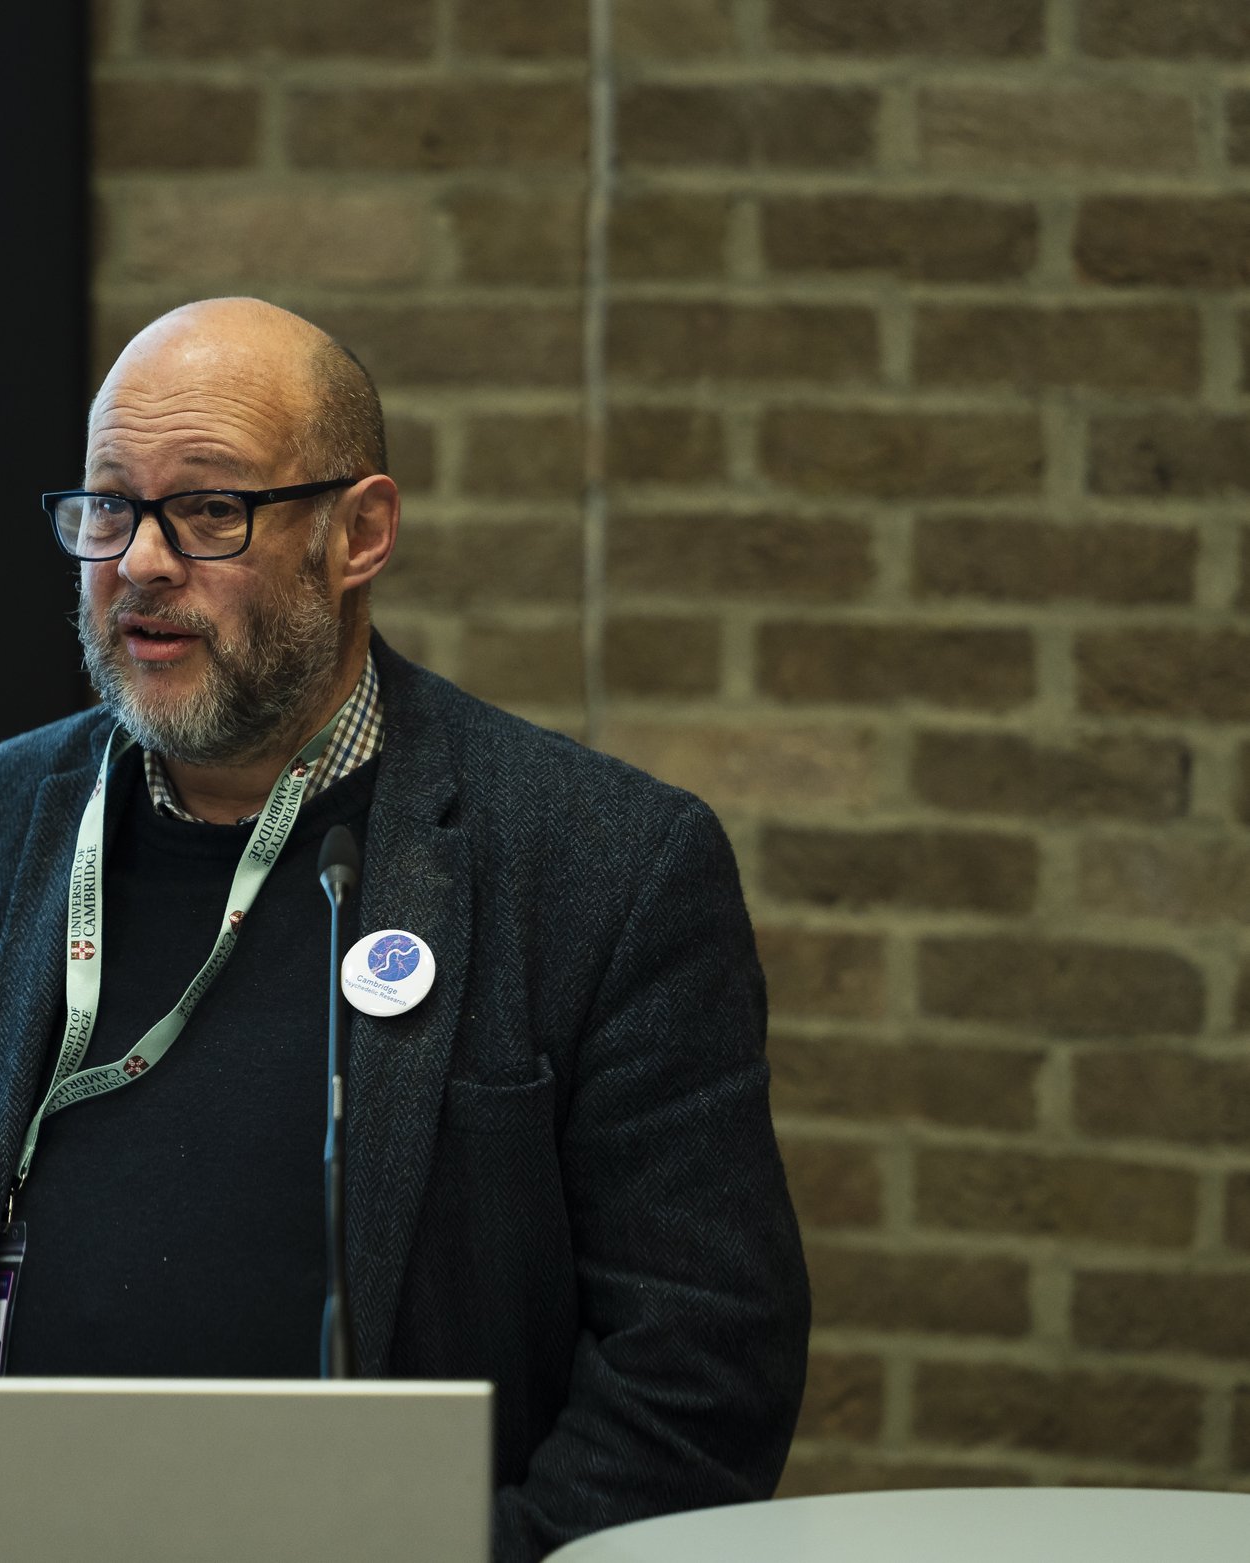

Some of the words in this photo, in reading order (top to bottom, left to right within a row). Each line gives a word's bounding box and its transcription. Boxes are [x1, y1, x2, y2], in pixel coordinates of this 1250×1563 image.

[248, 774, 291, 862] CAMBRIDGE
[272, 779, 302, 850] UNIVERSITY
[76, 848, 85, 863] OF
[262, 850, 276, 867] OF
[71, 864, 83, 938] UNIVERSITY
[83, 844, 97, 937] CAMBRIDGE
[176, 932, 232, 1017] CAMBRIDGE
[356, 974, 398, 995] Cambridge
[345, 978, 379, 996] Psychedelic
[379, 991, 407, 1007] Research
[70, 1006, 81, 1023] OF
[62, 1010, 92, 1079] MBRIDGE
[53, 1068, 120, 1100] CAMBRID
[57, 1076, 128, 1108] UNIVERSITY
